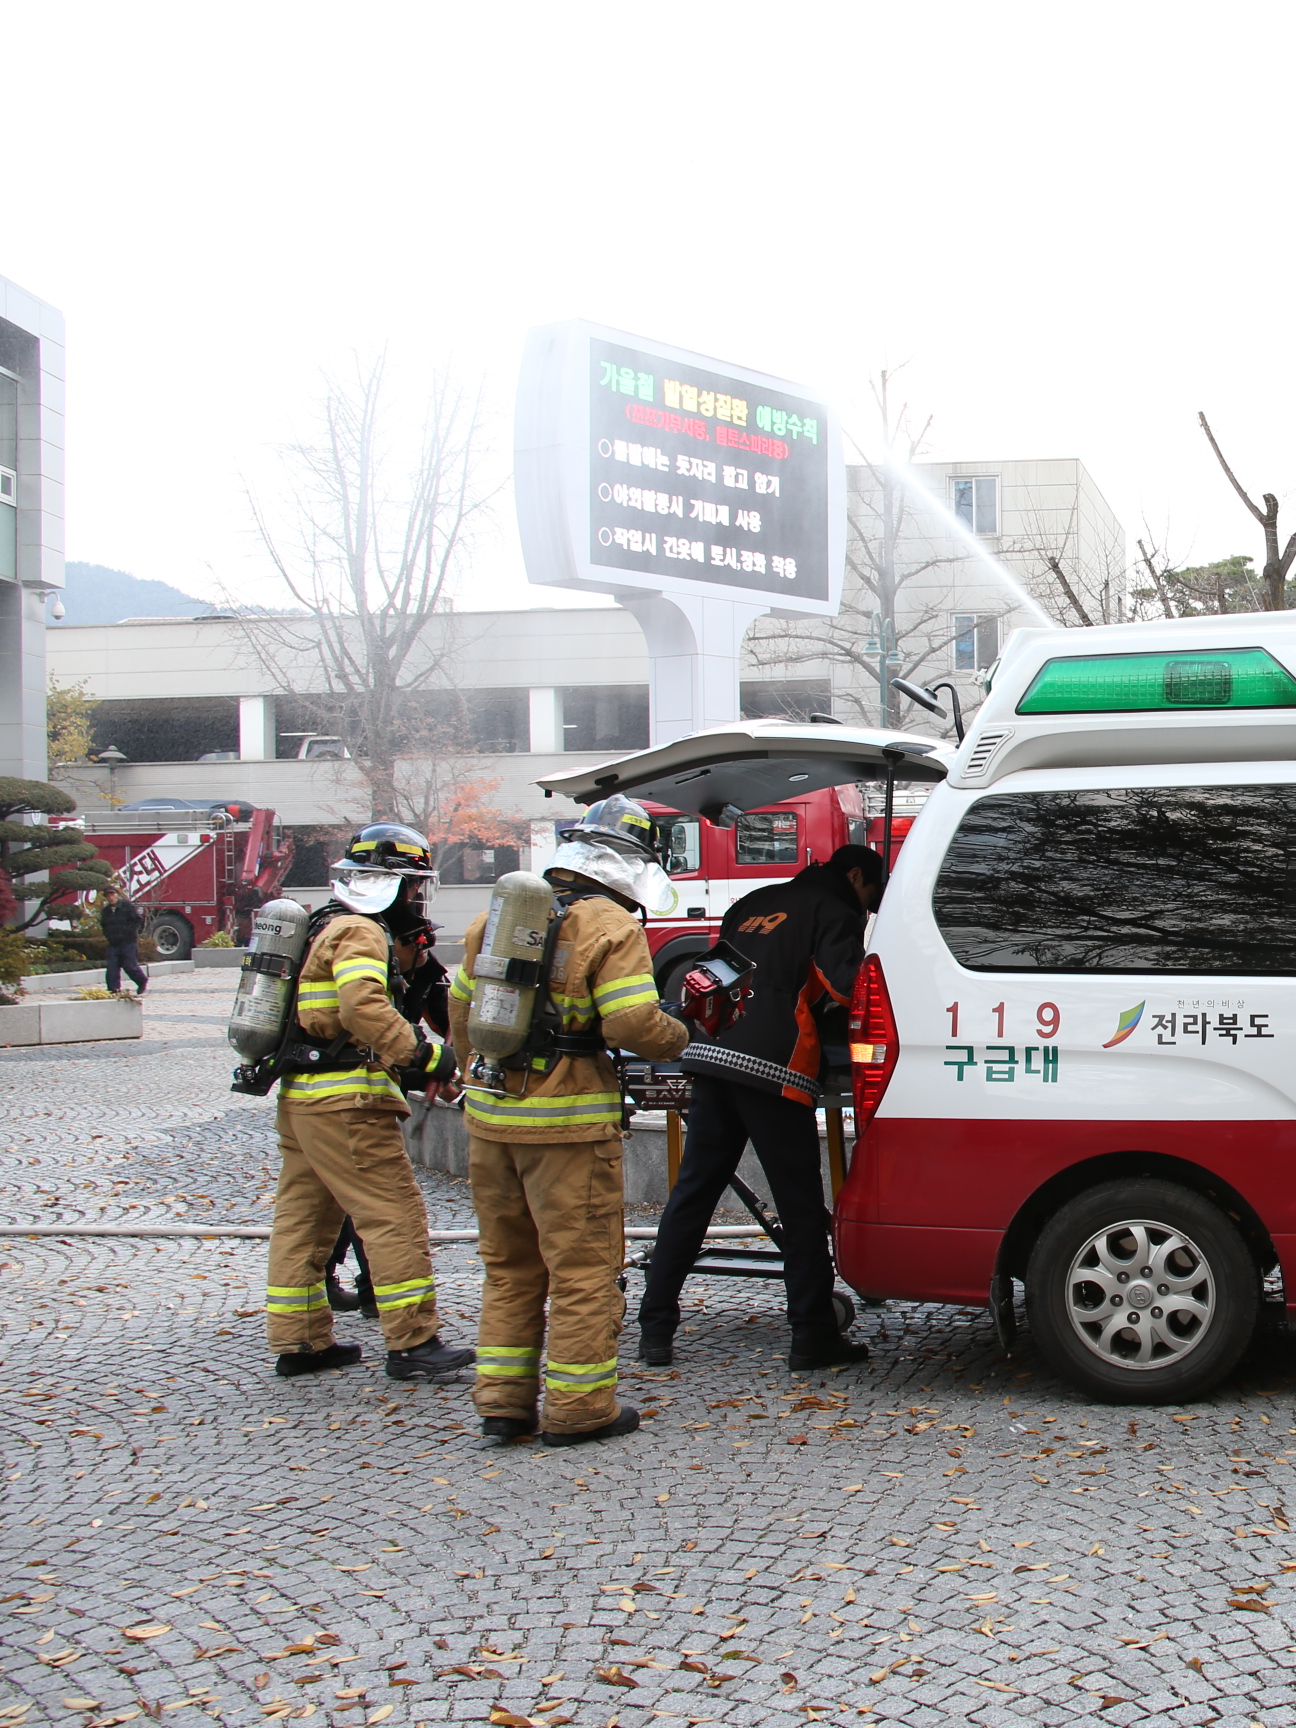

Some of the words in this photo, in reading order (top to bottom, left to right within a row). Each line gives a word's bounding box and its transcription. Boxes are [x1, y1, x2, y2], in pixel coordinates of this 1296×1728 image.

[599, 360, 655, 402] 가을철
[663, 378, 748, 427] 발열성질환
[756, 404, 819, 445] 예방수칙
[675, 453, 717, 484] 돗자리
[722, 464, 749, 490] 깔고
[754, 471, 780, 498] 앉기
[613, 483, 684, 518] 야외활동시
[689, 498, 730, 527] 기피제
[735, 509, 762, 534] 사용
[613, 527, 657, 556] 작업시
[663, 534, 705, 563] 긴옷에
[771, 555, 798, 580] 착용
[738, 912, 788, 935] 119
[1150, 1012, 1275, 1046] 전라북도
[943, 1045, 1059, 1083] 구급대
